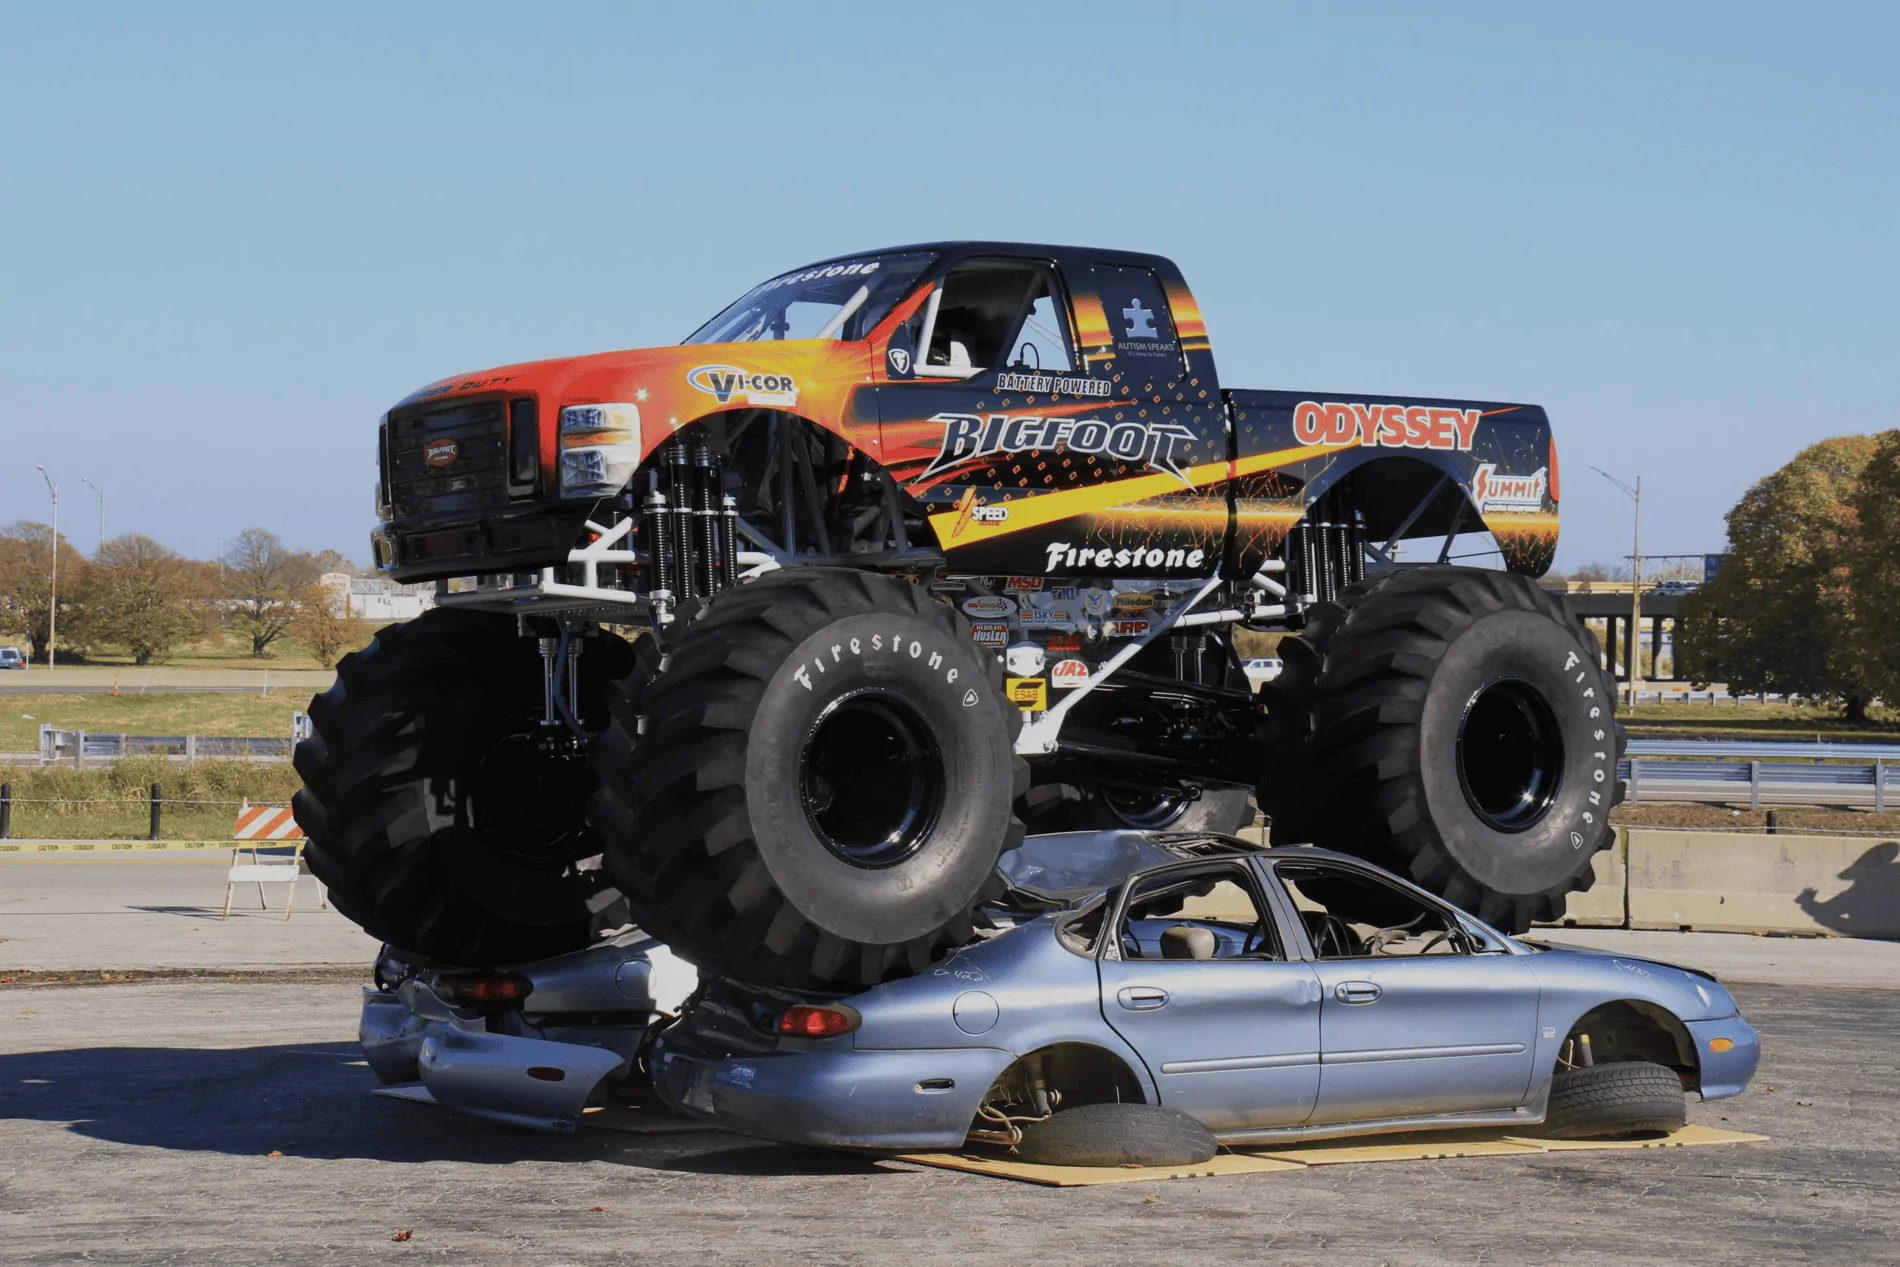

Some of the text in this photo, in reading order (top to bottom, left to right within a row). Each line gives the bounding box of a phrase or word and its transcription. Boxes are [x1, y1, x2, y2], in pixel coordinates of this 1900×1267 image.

[1118, 342, 1175, 351] AUTISM SPEAKS
[708, 372, 793, 403] VI-COR
[998, 374, 1111, 396] BATTERY POWERED
[1294, 401, 1481, 450] ODYSSEY
[914, 412, 1199, 494] BIGFOOT
[972, 506, 1009, 521] SPEED
[1045, 541, 1205, 573] Firestone
[1007, 576, 1043, 589] MSD
[1034, 611, 1053, 620] ISKY
[794, 633, 959, 691] Firestone
[1014, 690, 1038, 700] ESAB
[1564, 651, 1606, 824] Firestone
